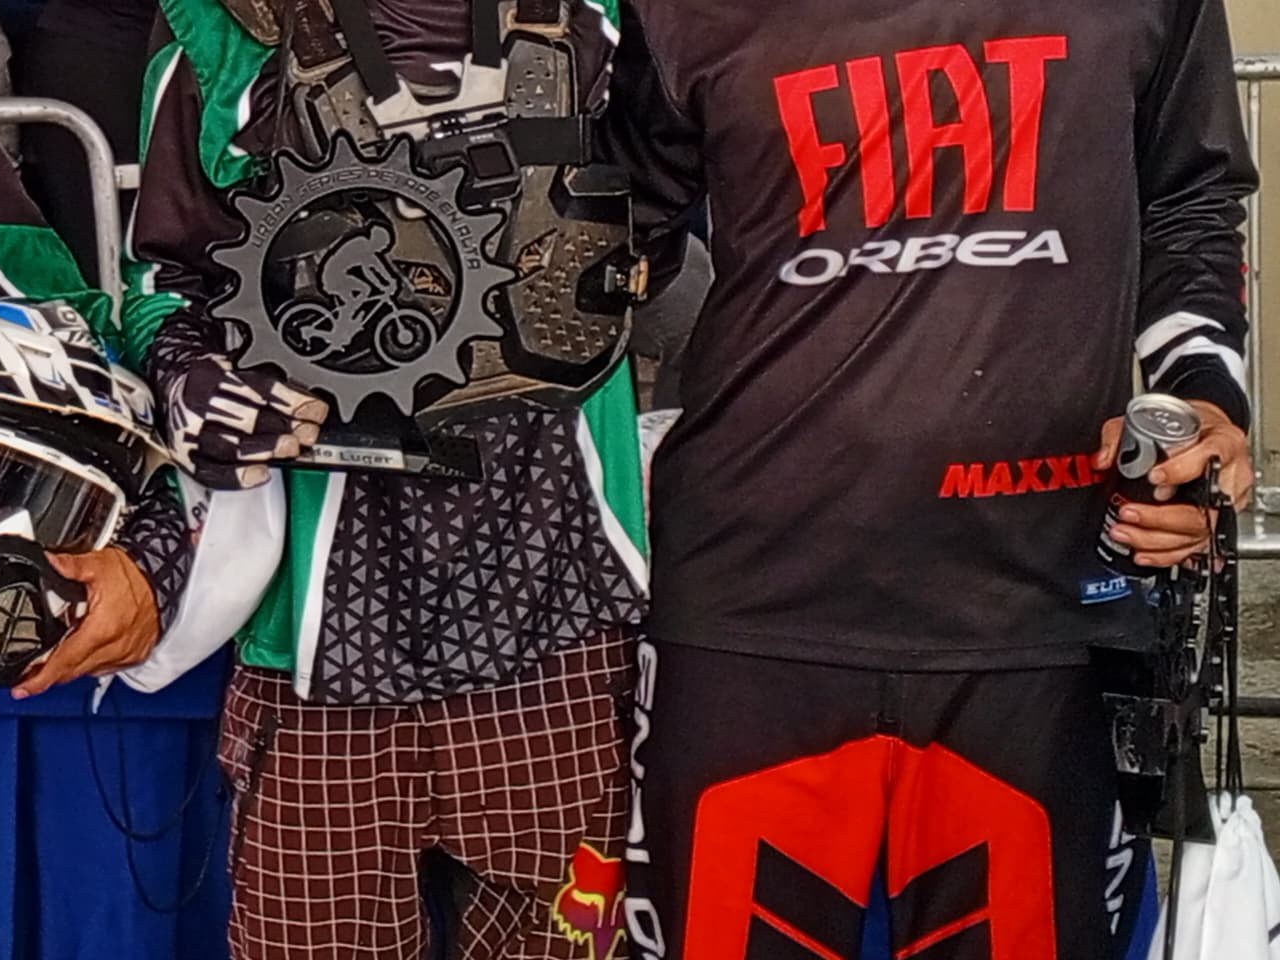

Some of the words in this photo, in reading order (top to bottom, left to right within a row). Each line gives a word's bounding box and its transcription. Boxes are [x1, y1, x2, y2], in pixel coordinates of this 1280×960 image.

[773, 35, 1067, 237] FIAT
[252, 196, 295, 248] URBAN
[438, 202, 466, 224] EN
[779, 230, 1069, 286] ORBEA
